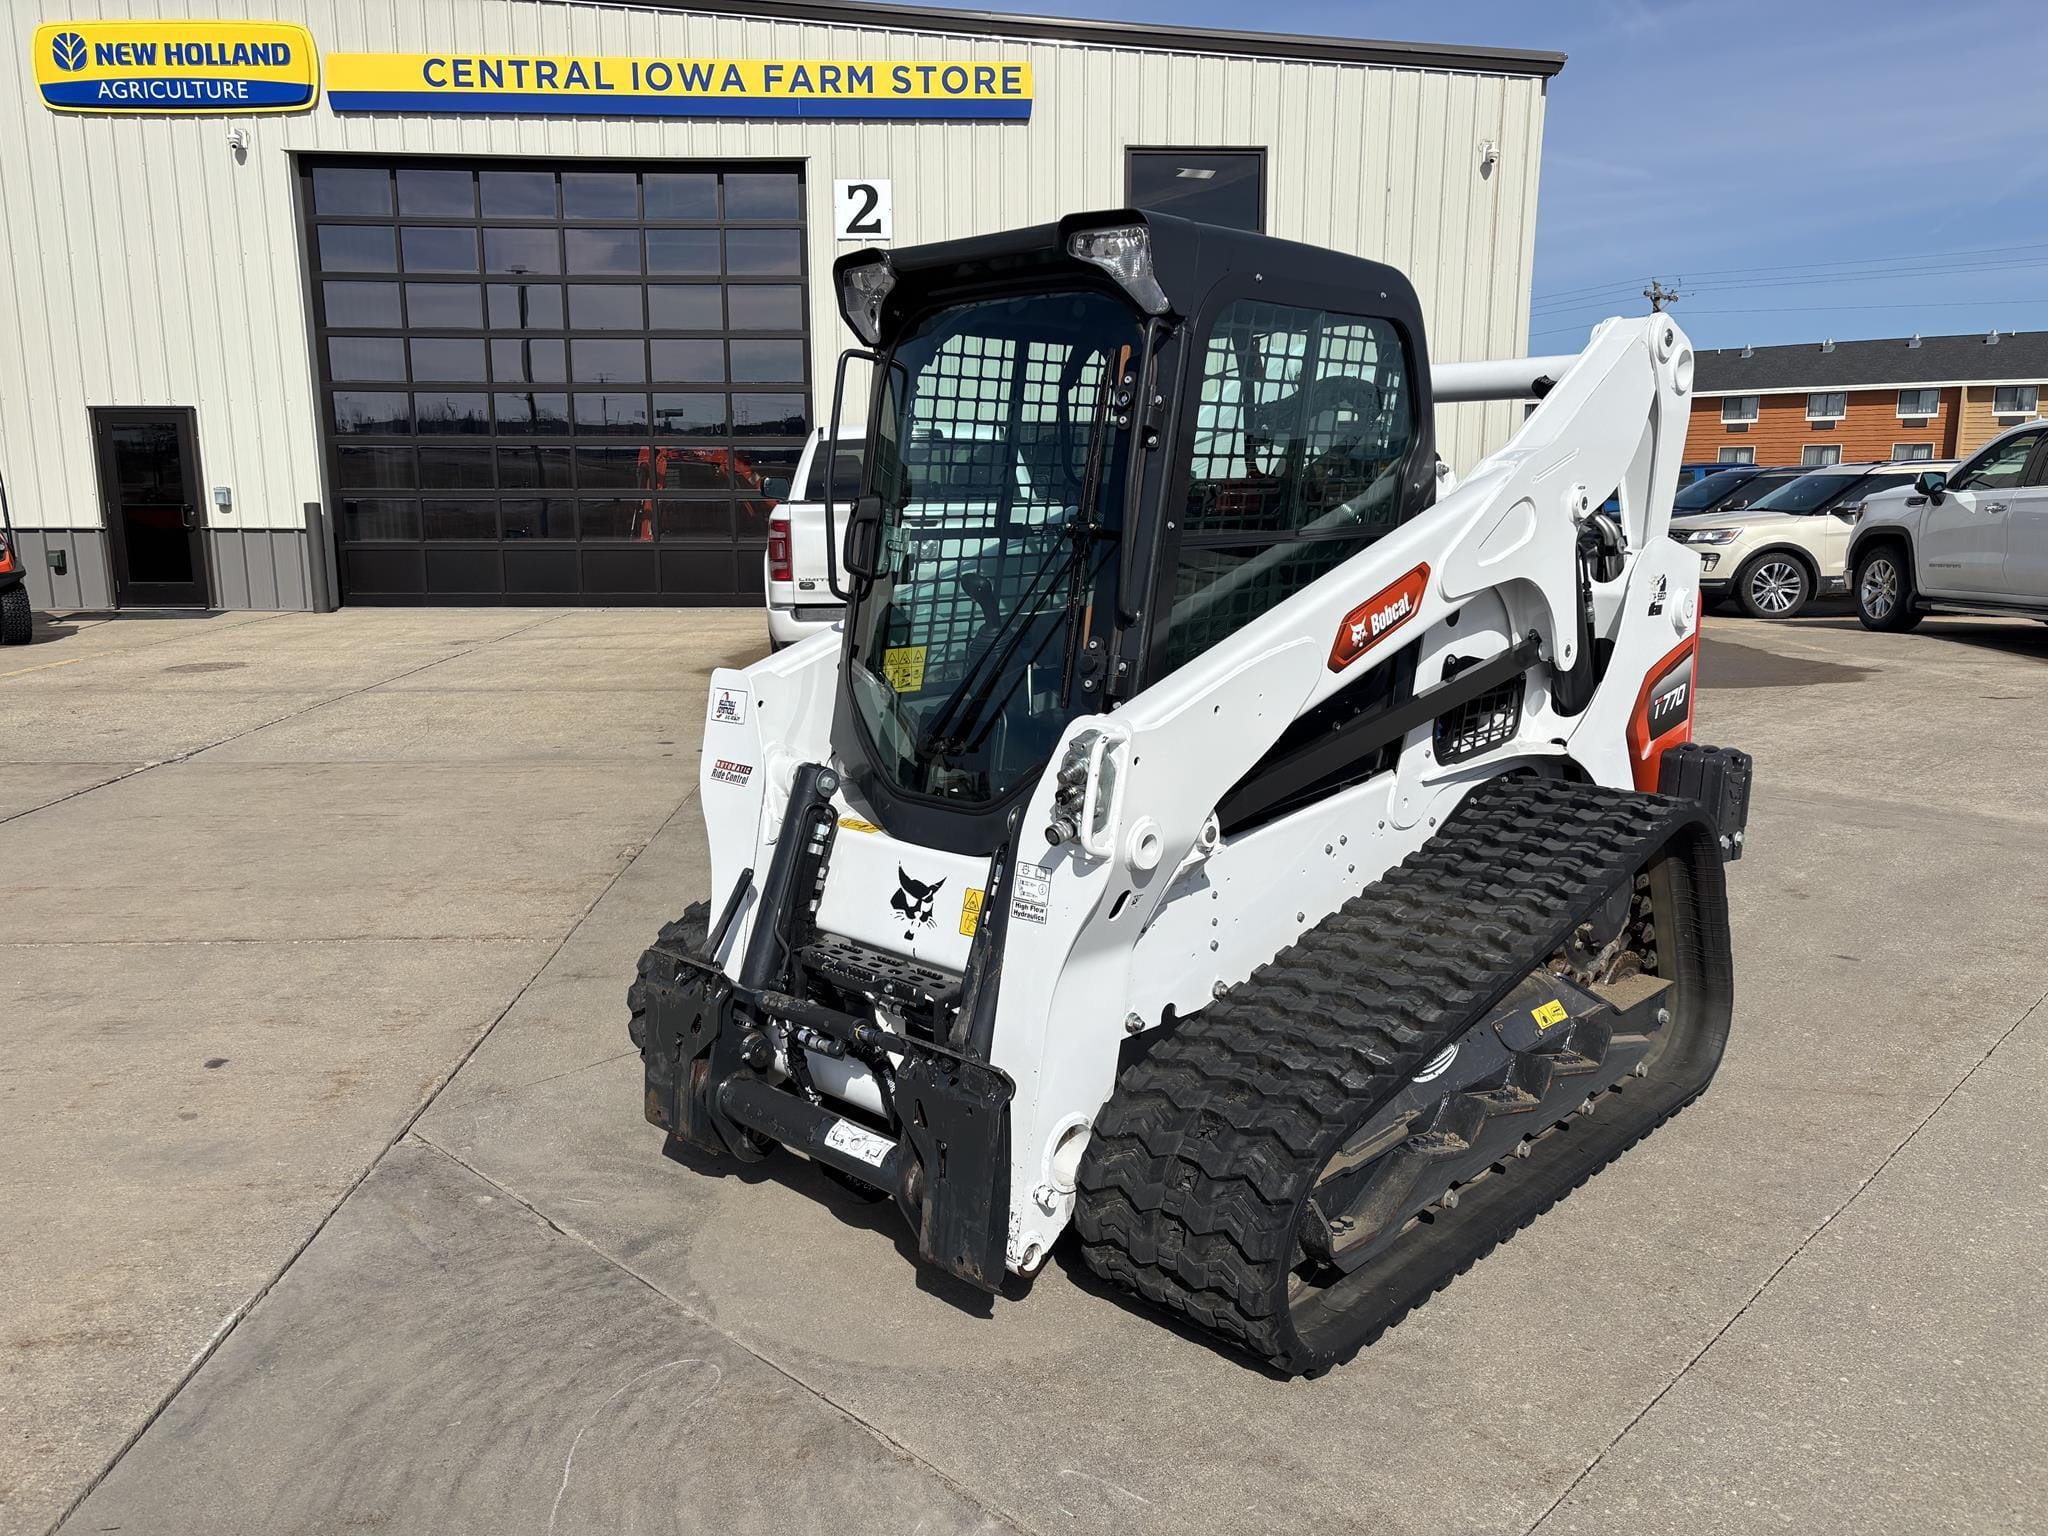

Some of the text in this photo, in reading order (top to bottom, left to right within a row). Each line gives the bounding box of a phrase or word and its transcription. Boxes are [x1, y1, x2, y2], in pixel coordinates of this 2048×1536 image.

[95, 42, 291, 66] NEW HOLLAND
[423, 58, 1022, 94] CENTRAL IOWA FARM STORE
[98, 80, 249, 99] AGRICULTURE
[846, 183, 882, 235] 2
[1370, 592, 1410, 636] Bobcat
[1654, 683, 1687, 720] T770
[711, 768, 749, 785] Ride Control
[1013, 909, 1045, 922] Hydraulics
[1015, 902, 1045, 914] High Flow
